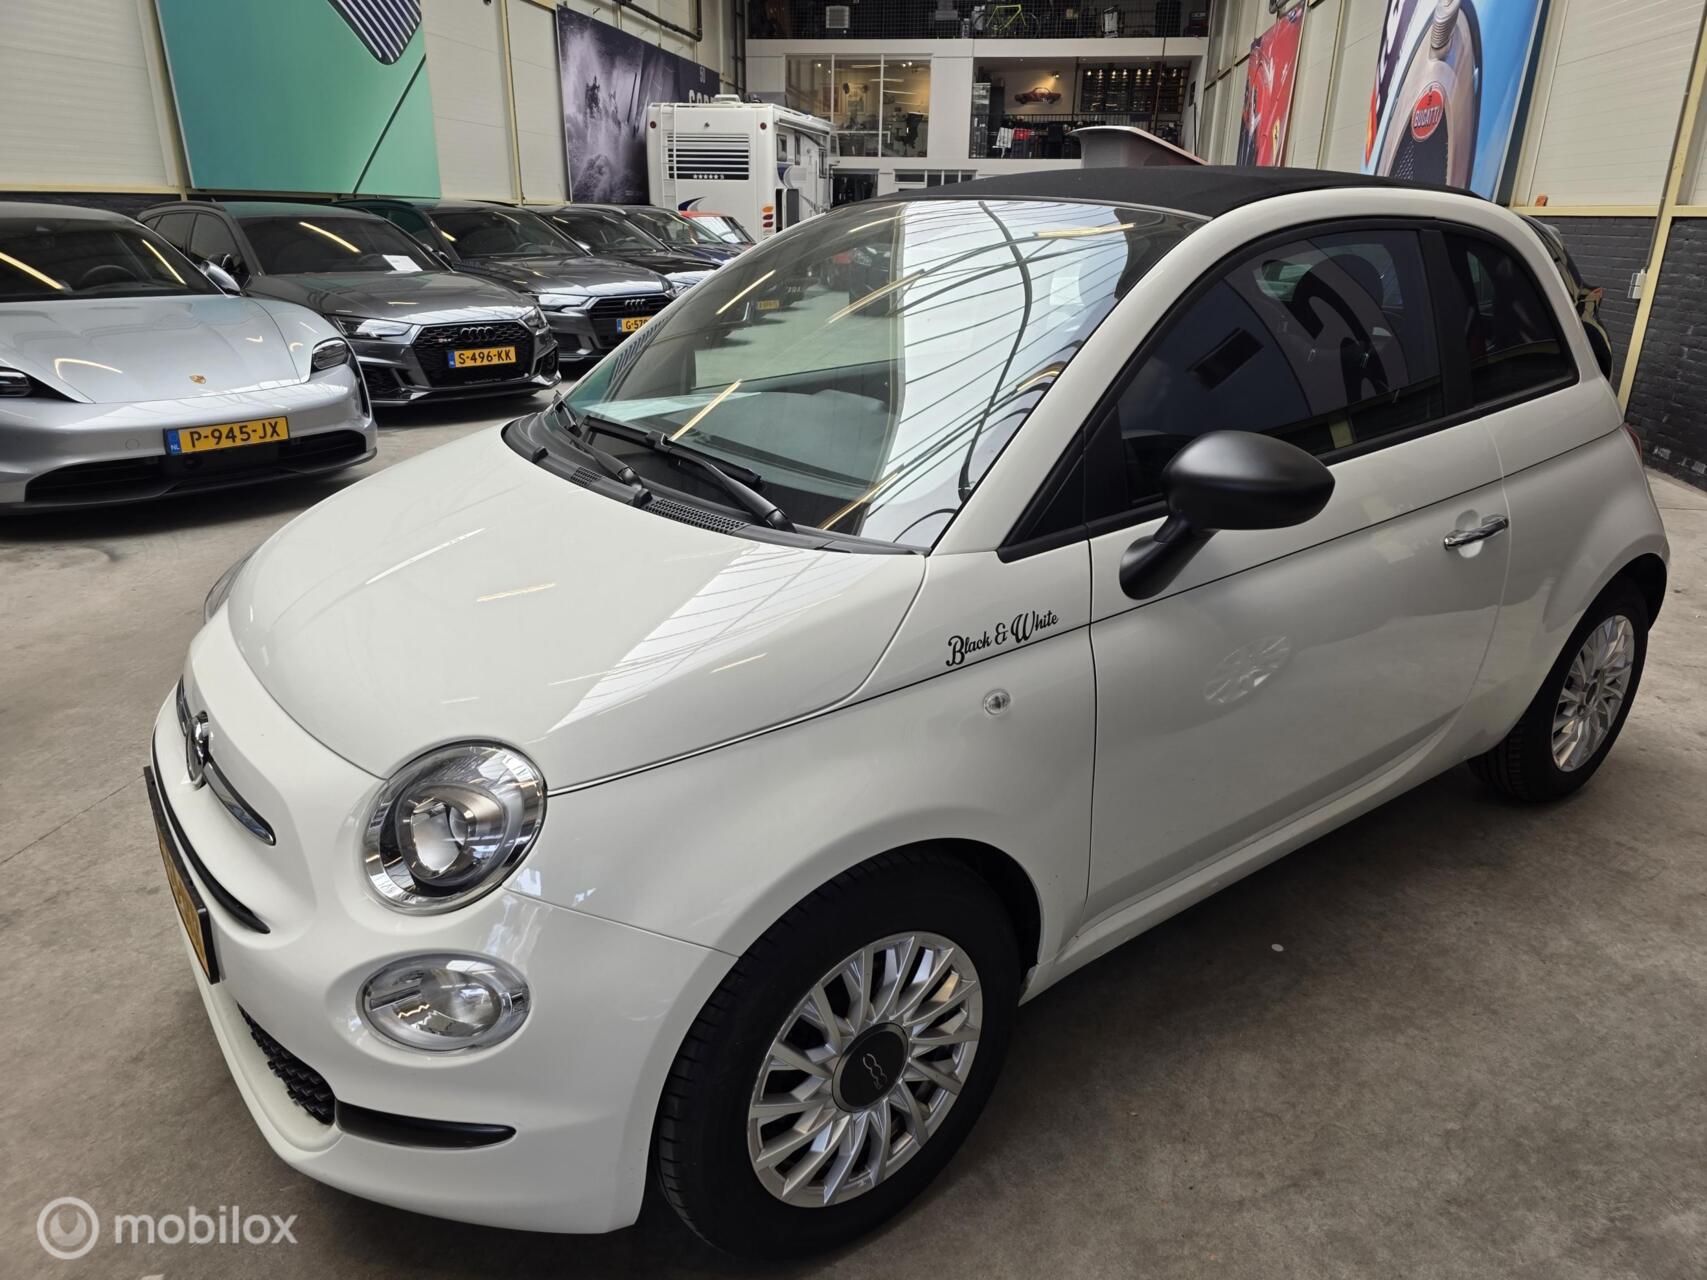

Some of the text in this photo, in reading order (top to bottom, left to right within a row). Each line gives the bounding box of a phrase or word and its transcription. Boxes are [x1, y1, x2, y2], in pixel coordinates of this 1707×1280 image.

[1413, 106, 1441, 128] BUGATTI
[458, 349, 512, 365] S-496-KK
[189, 421, 281, 448] P-945-JX
[945, 609, 1059, 667] Black & White
